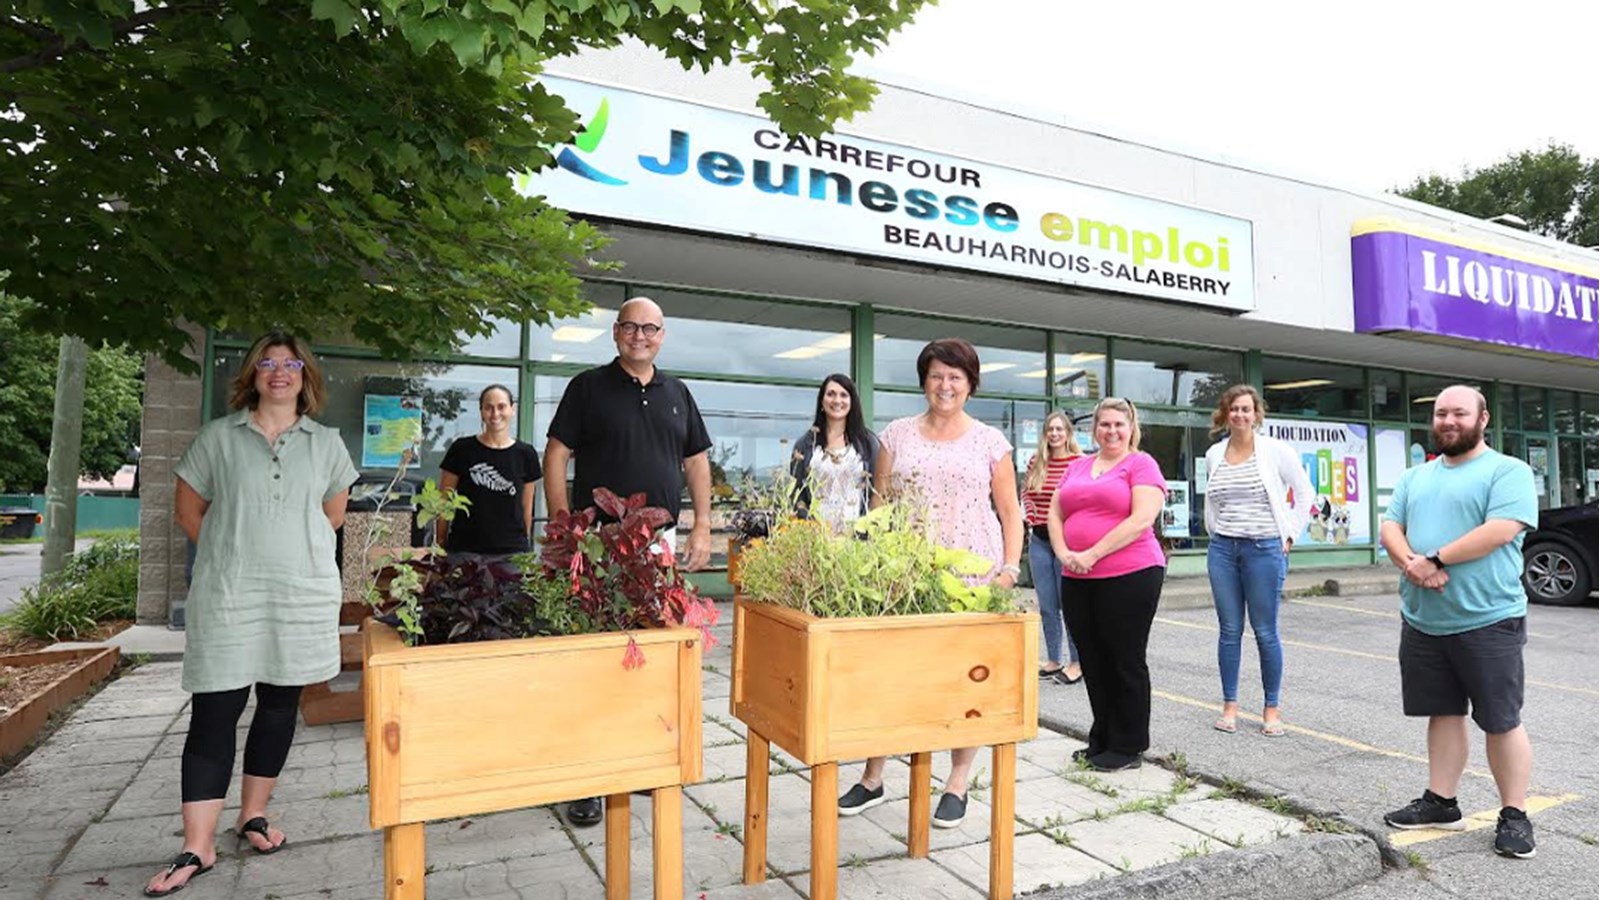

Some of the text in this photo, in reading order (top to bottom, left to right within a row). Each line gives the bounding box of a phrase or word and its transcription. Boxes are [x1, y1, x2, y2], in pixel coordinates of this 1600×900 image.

[754, 129, 981, 188] CARREFOUR
[638, 129, 1231, 272] Jeunesse emploi
[884, 225, 1231, 296] BEAUHARNOIS-SALABERRY
[1422, 250, 1599, 322] LIQUIDAT
[1269, 425, 1347, 443] LIQUIDATION
